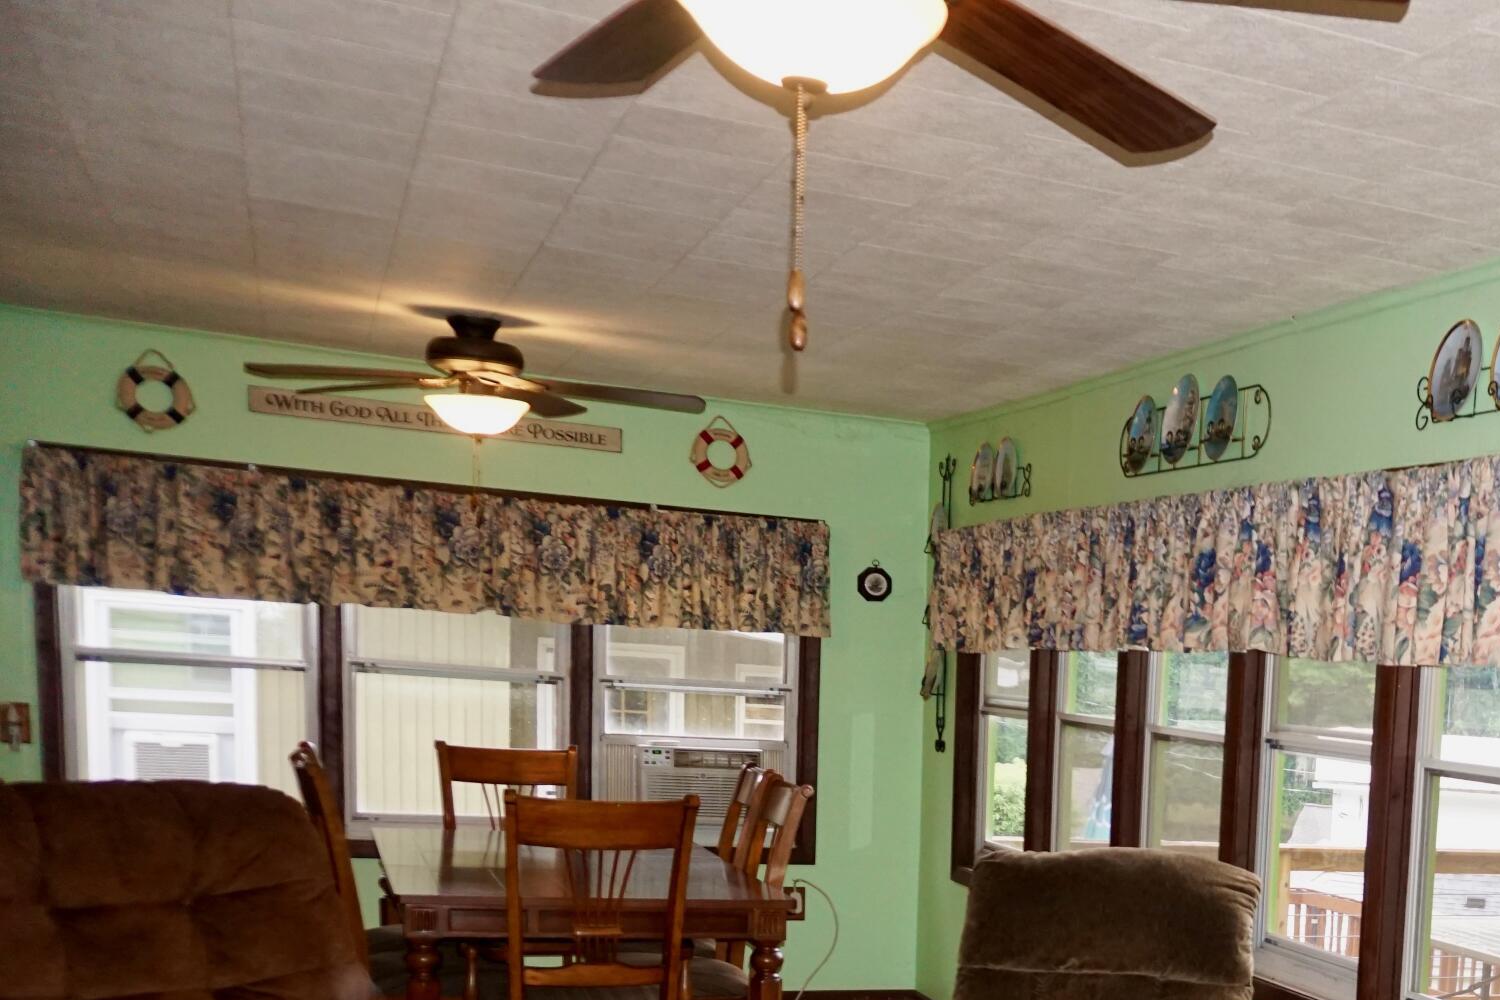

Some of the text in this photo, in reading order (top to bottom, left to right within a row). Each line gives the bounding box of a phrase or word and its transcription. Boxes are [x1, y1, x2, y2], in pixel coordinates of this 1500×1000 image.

[265, 393, 325, 413] WITH
[329, 400, 371, 418] GOD
[376, 406, 413, 424] ALL
[527, 423, 607, 446] POSSIBLE
